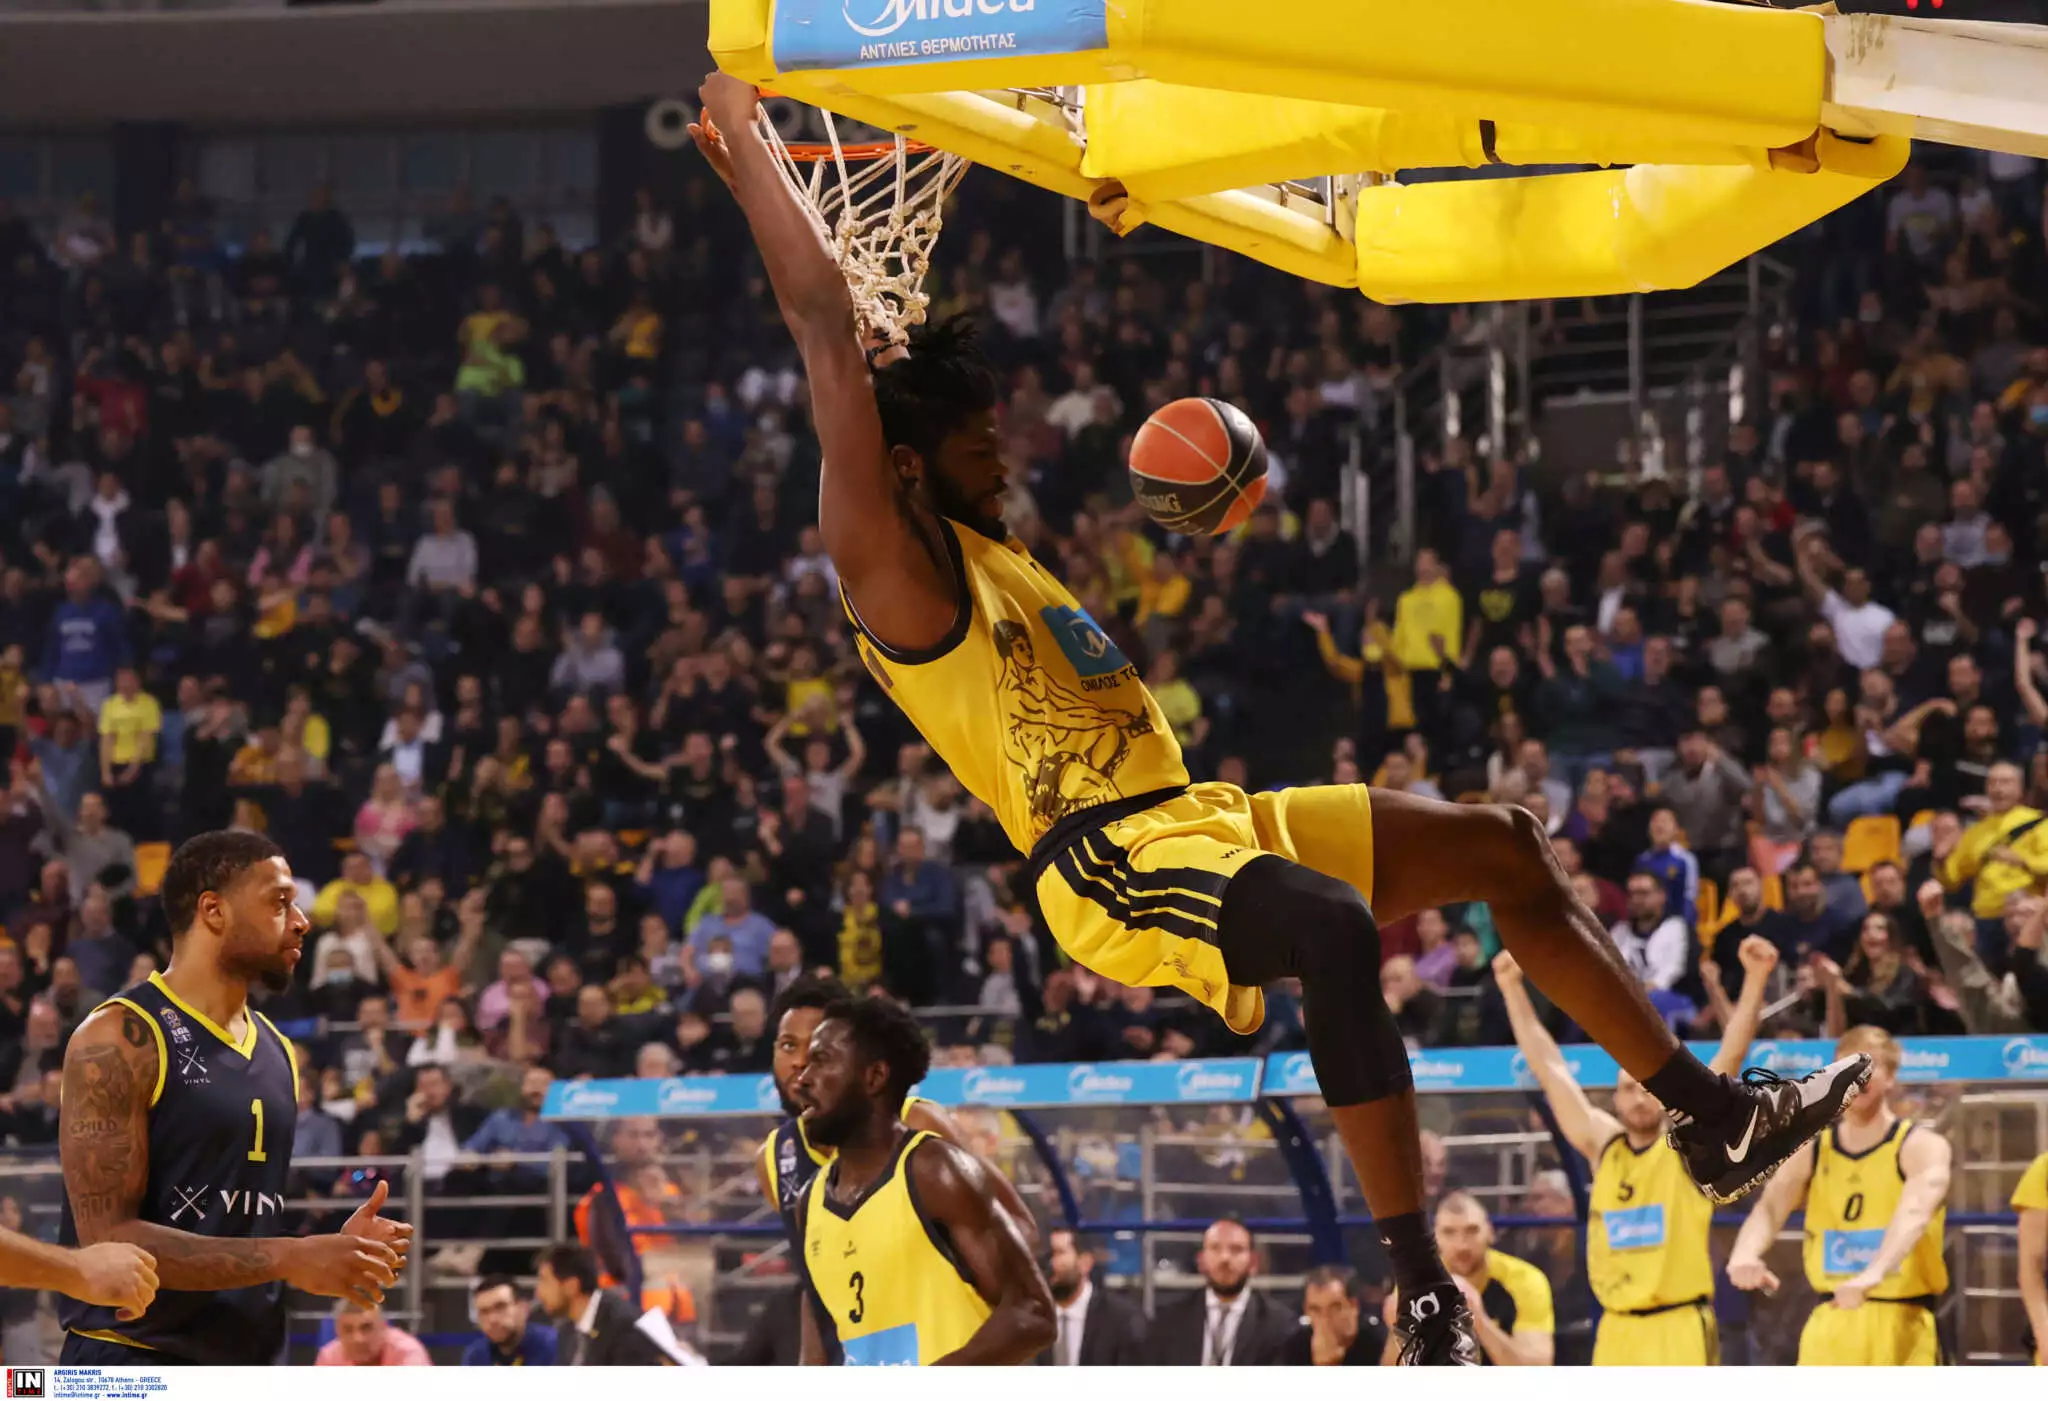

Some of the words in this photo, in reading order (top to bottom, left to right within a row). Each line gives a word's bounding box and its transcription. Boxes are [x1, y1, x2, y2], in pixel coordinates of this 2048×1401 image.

[859, 41, 918, 60] ΑΝΤΛΙΕΣ
[921, 33, 1016, 56] ΘΕΡΜΟΤΗΤΑΣ
[183, 1077, 211, 1085] VINYL
[247, 1099, 267, 1162] 1
[1617, 1182, 1635, 1202] 5
[1843, 1192, 1864, 1222] 0
[848, 1271, 865, 1324] 3
